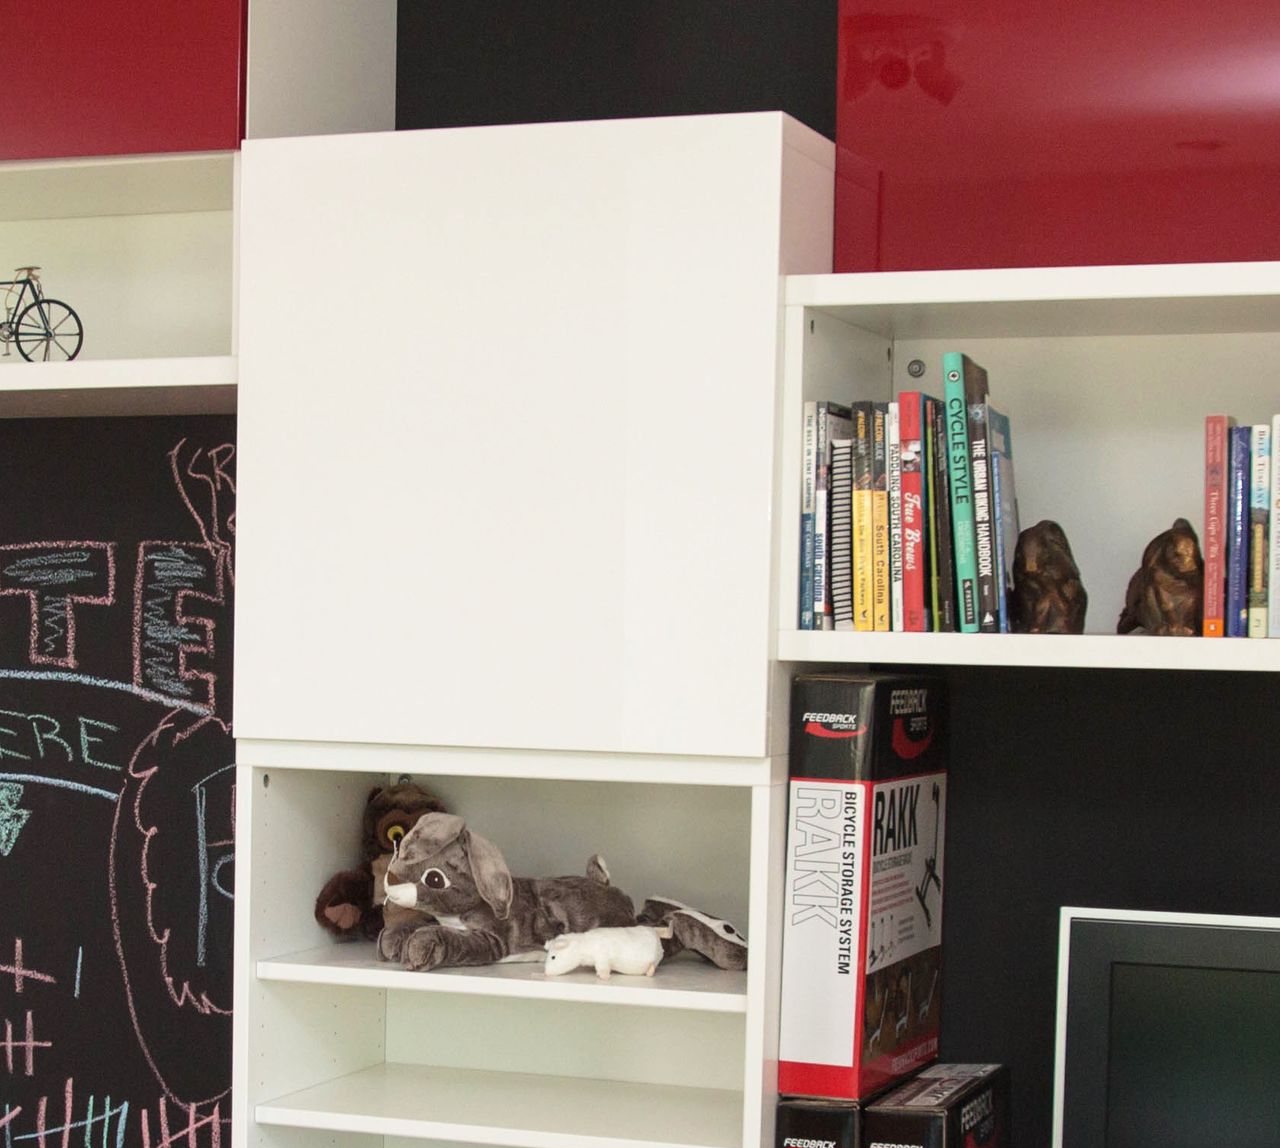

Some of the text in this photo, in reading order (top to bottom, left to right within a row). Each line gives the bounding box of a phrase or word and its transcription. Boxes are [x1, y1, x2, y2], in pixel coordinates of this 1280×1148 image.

[949, 398, 970, 505] CYCLE STYLE
[971, 439, 986, 459] THE
[973, 459, 988, 491] URBAN
[889, 443, 903, 582] PADDLING SOUTH CAROLINA
[904, 491, 921, 571] True Brews
[974, 492, 991, 522] BIKING
[876, 525, 885, 556] South
[976, 523, 993, 577] HANDBOOK
[876, 559, 886, 604] Carolina
[802, 712, 857, 725] FEEDBACK
[831, 722, 857, 731] SPORTS
[873, 783, 921, 857] RAKK
[791, 787, 843, 929] RAKK
[837, 791, 858, 975] BICYCLE STORAGE SYSTEM
